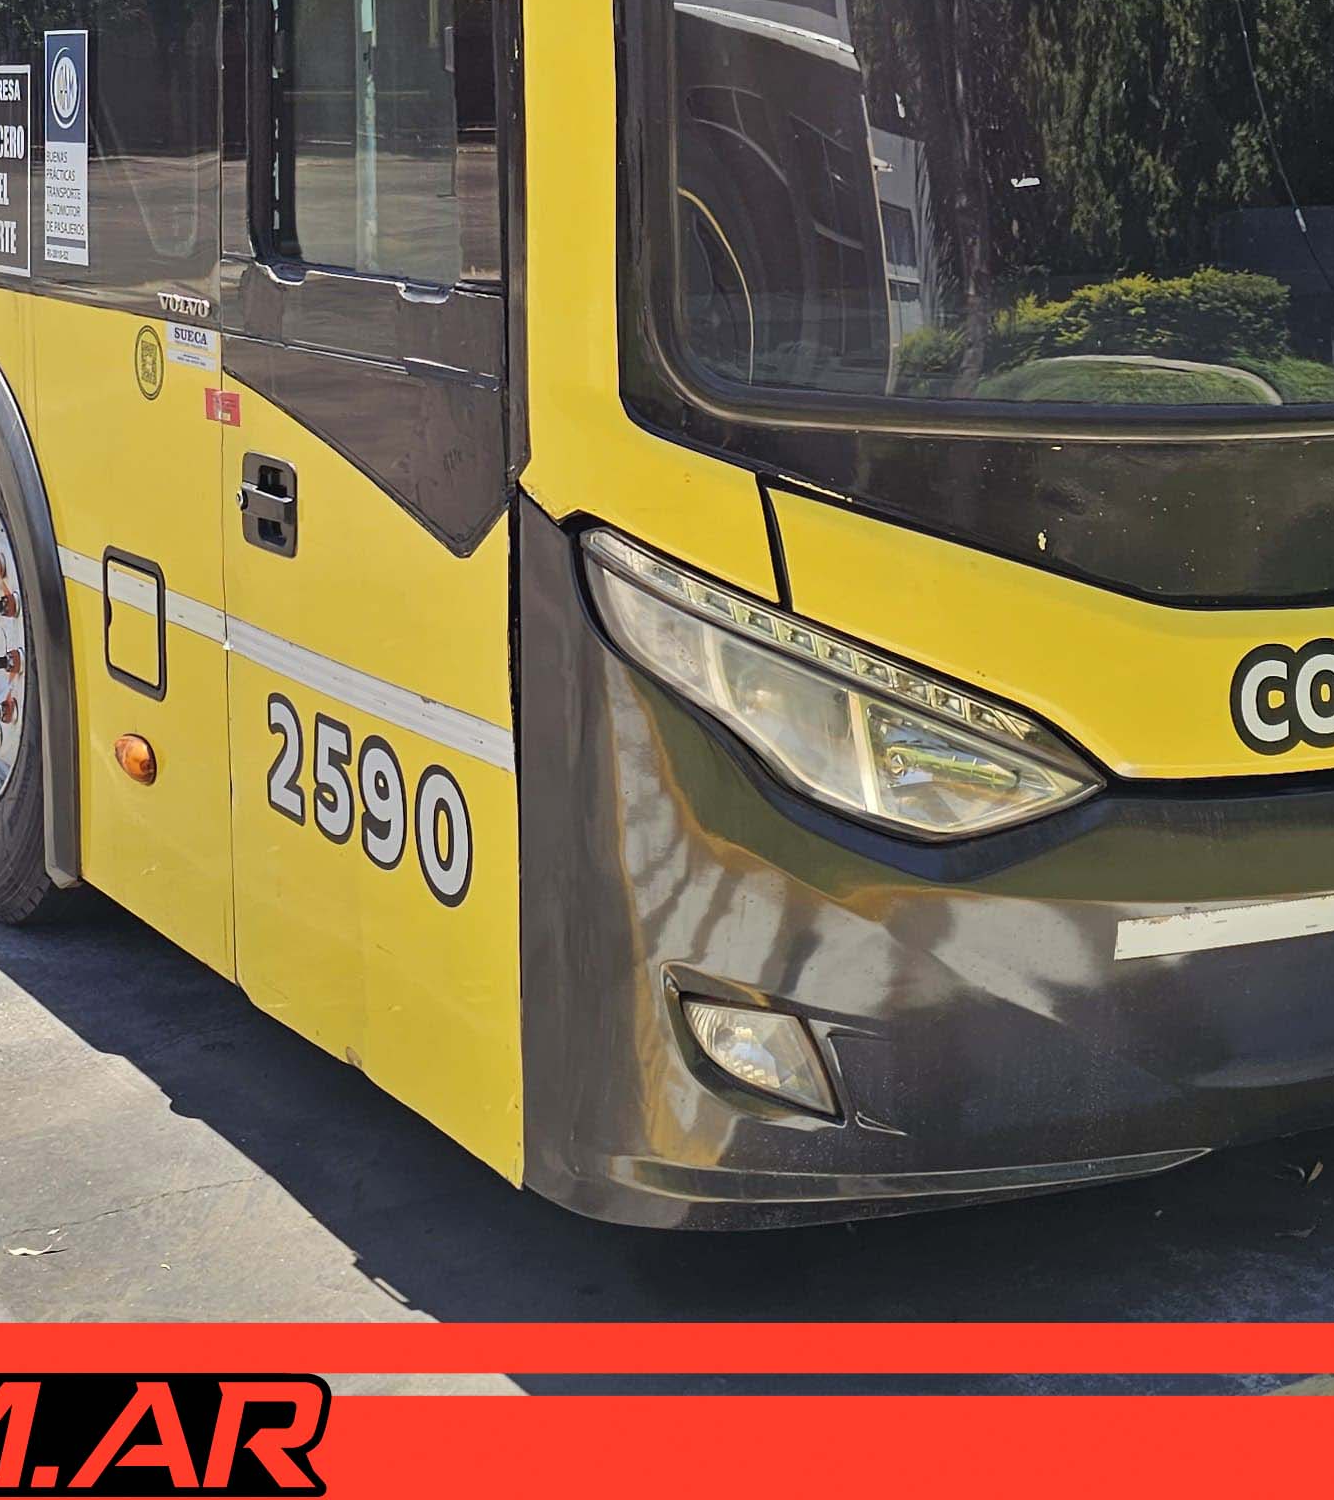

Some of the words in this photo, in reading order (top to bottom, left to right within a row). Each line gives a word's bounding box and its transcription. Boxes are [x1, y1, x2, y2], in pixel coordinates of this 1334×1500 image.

[157, 292, 212, 318] VOLVO
[174, 326, 208, 346] SUECA
[267, 691, 473, 908] 2590
